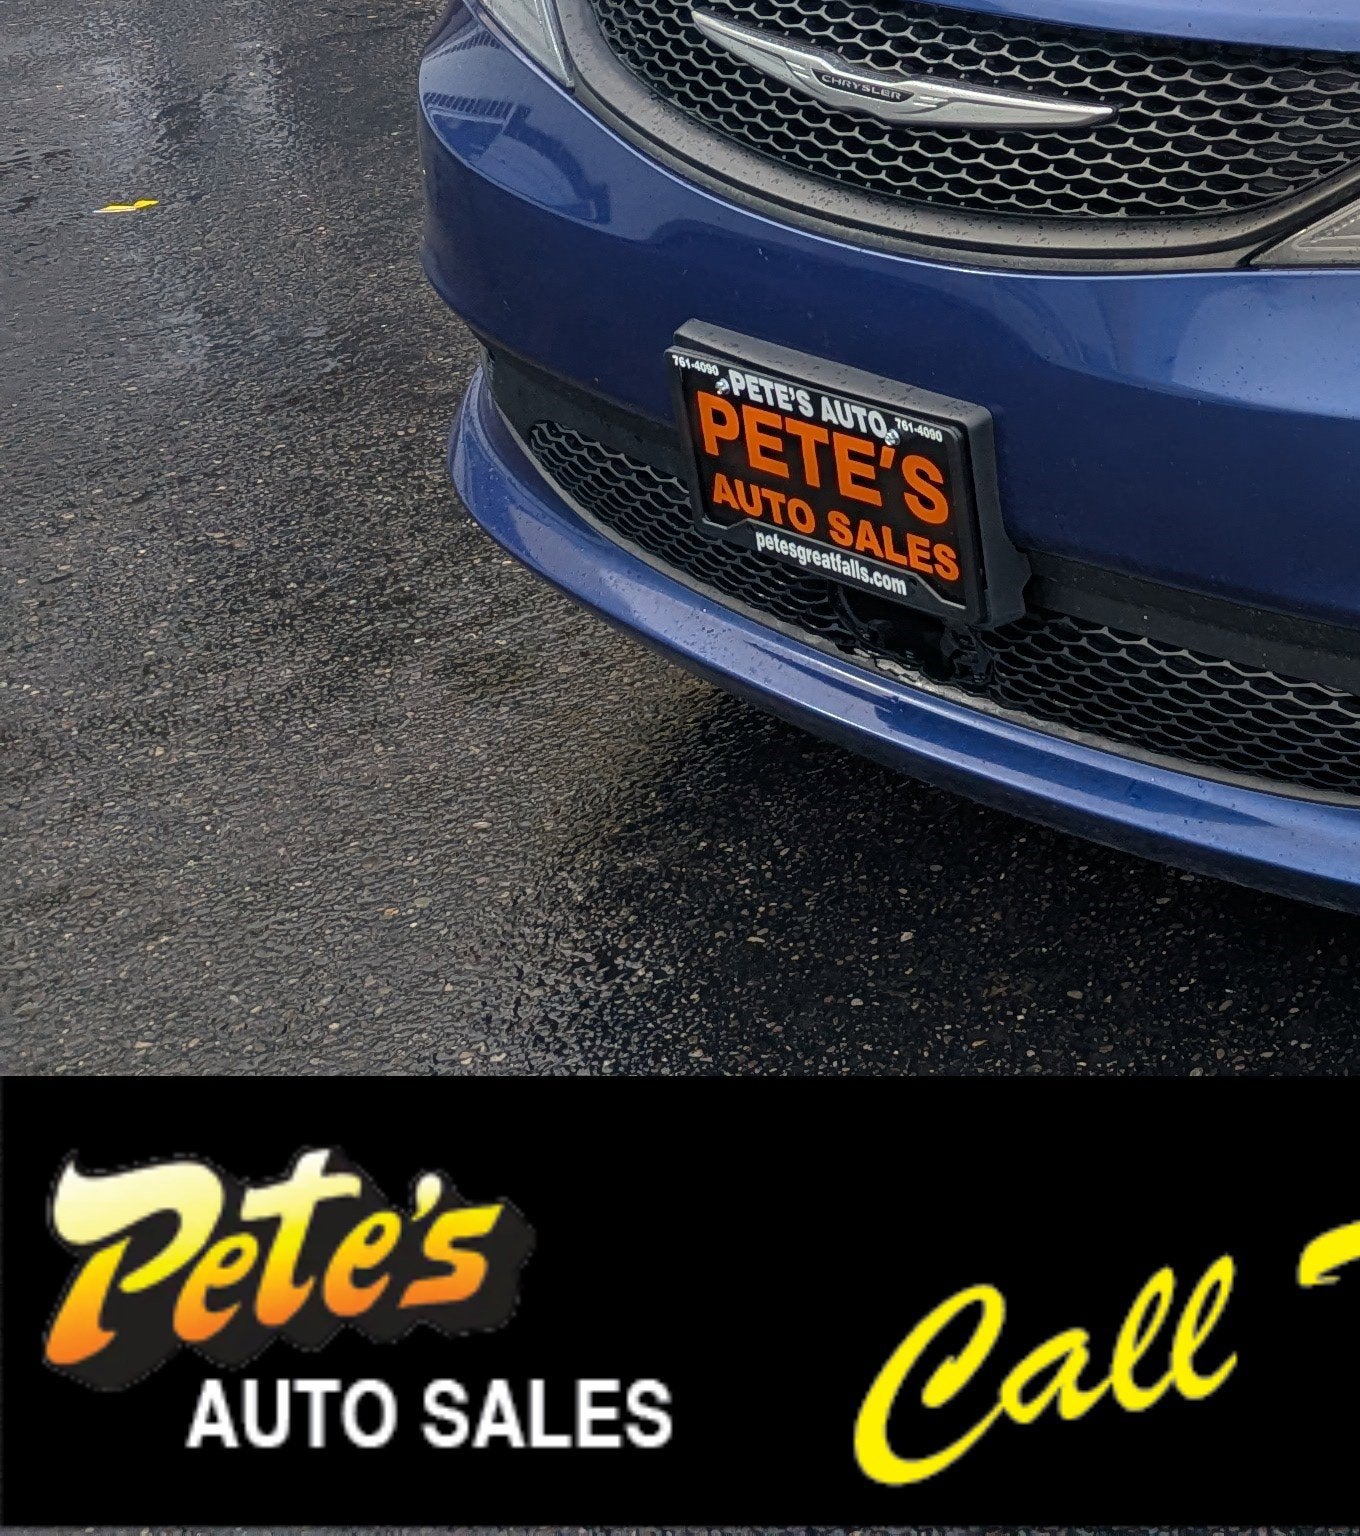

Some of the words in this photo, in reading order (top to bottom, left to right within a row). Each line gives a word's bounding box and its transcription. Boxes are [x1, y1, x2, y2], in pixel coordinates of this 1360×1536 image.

[821, 74, 902, 100] CHRYSLER
[672, 354, 720, 377] 761-4090
[728, 369, 814, 418] PETE'S
[820, 396, 888, 439] AUTO
[895, 417, 943, 443] 761-4090
[697, 390, 950, 525] PETE'S
[713, 472, 816, 534] AUTO
[827, 510, 960, 581] SALES
[755, 531, 908, 596] petesgreatfalls.com
